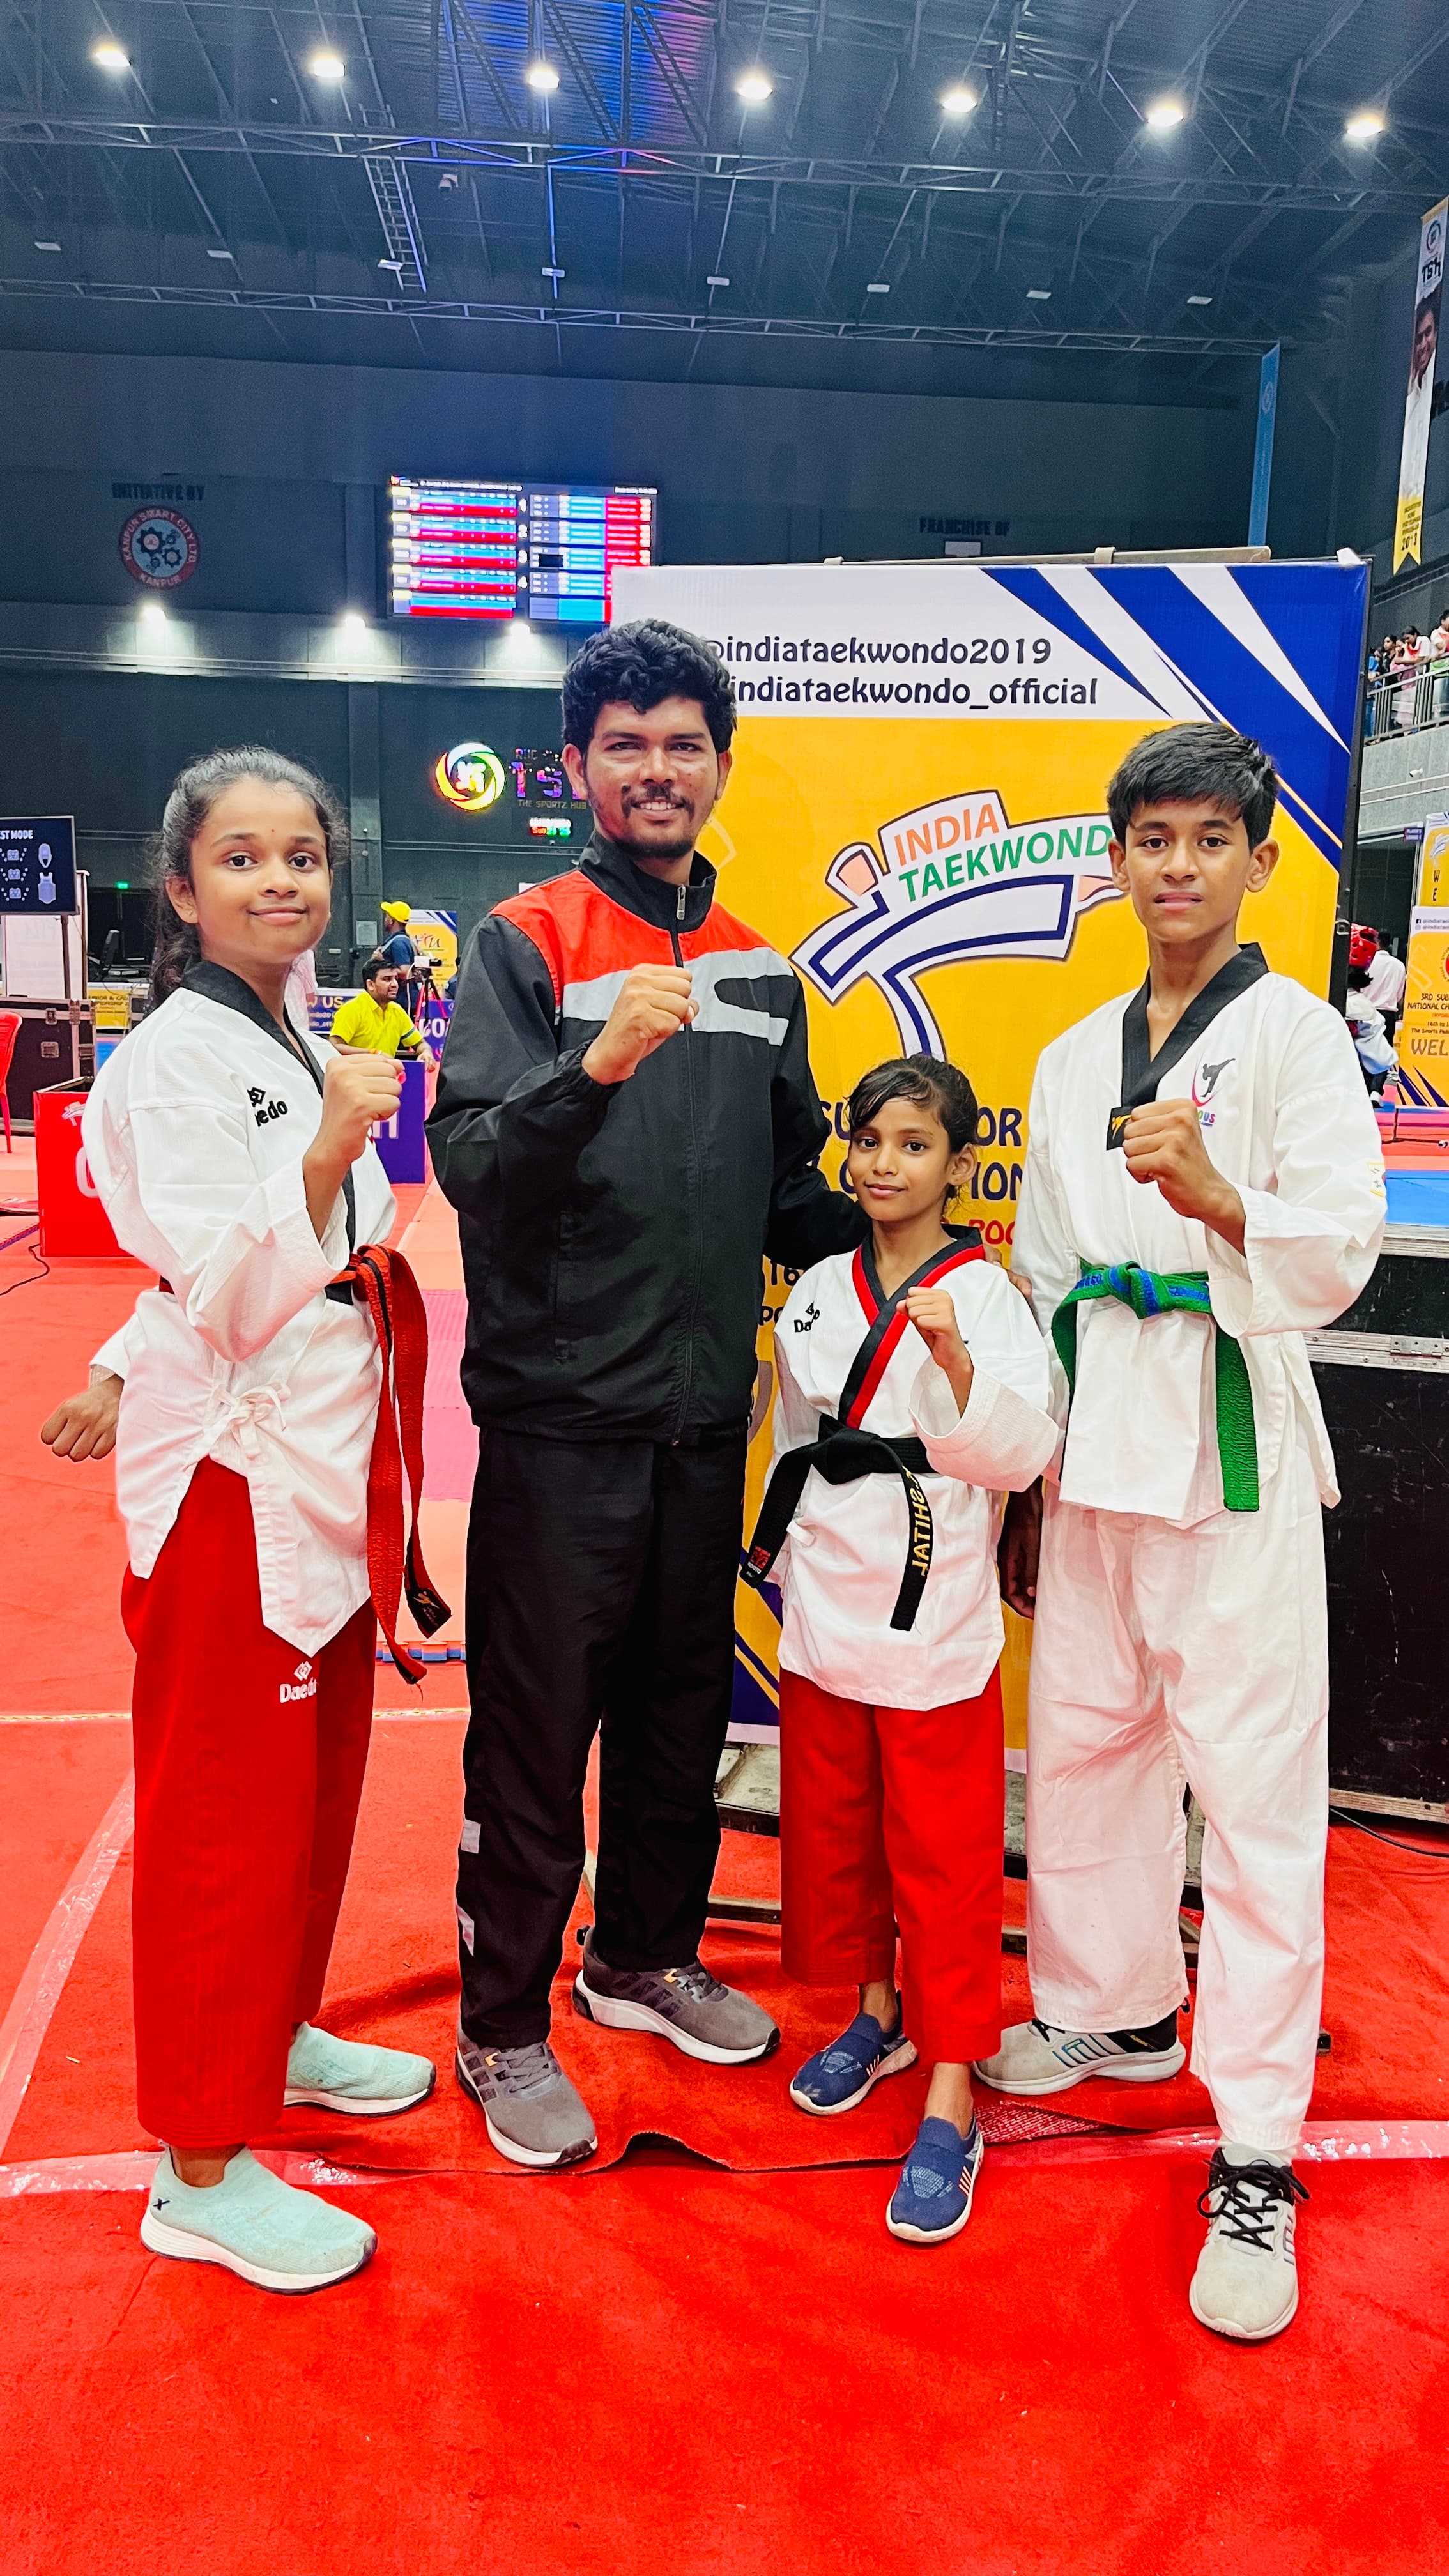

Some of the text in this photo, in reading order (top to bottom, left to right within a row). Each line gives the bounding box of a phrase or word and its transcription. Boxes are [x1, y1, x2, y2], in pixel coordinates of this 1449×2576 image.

[121, 519, 140, 561] KANPUR
[139, 509, 176, 521] SMART
[177, 518, 195, 540] CITY
[920, 518, 991, 535] FRANCHISE
[139, 573, 182, 588] KANPUR
[706, 636, 1052, 664] indiataekwondo2019
[536, 801, 567, 809] SPORTZ
[11, 829, 34, 839] MODE
[894, 803, 1000, 867] INDIA
